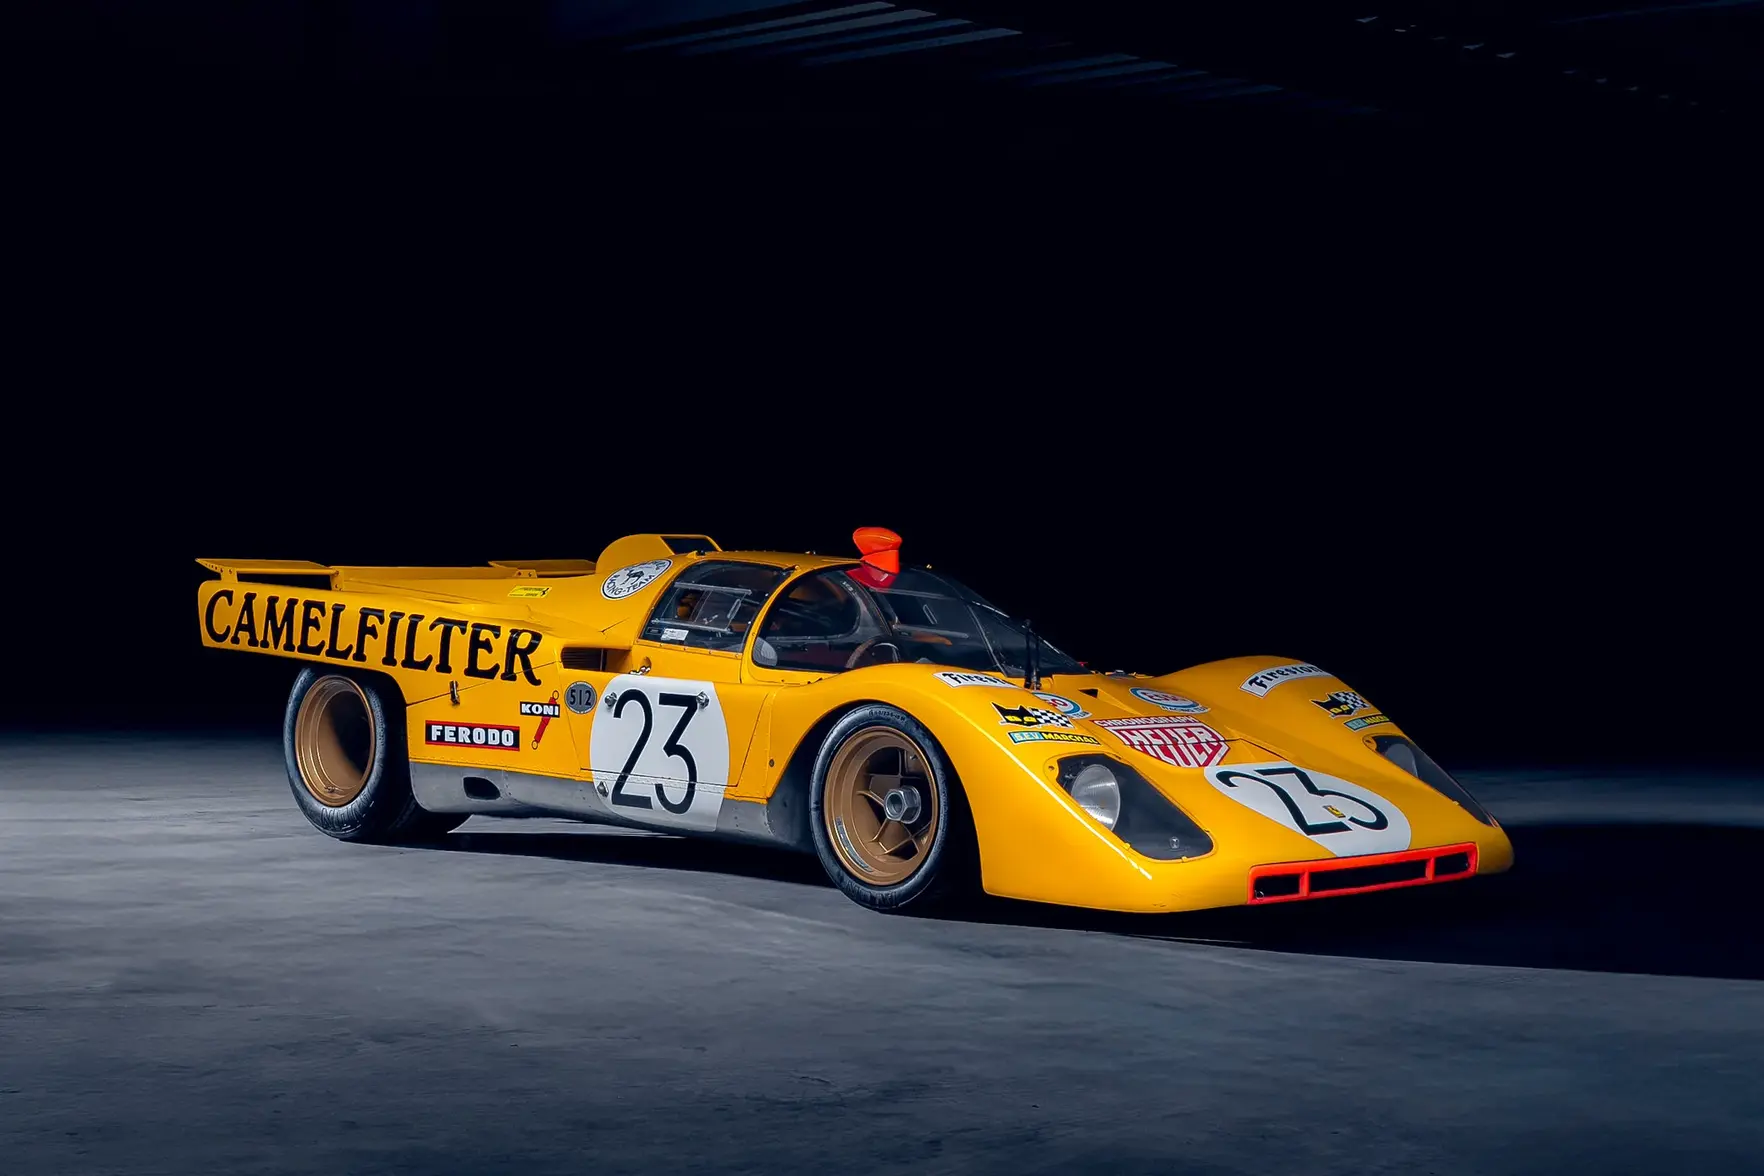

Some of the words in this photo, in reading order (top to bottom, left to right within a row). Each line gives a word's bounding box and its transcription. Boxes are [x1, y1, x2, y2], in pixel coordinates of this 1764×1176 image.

[204, 589, 543, 686] CAMELFILTER
[1248, 665, 1323, 689] Fireston
[570, 689, 592, 706] 512
[521, 703, 559, 716] KONI
[1093, 715, 1200, 727] CHRONOGRAPH
[431, 725, 514, 746] FERODO
[1041, 731, 1099, 745] MARCHAL
[611, 689, 698, 815] 23
[1216, 767, 1389, 836] 23
